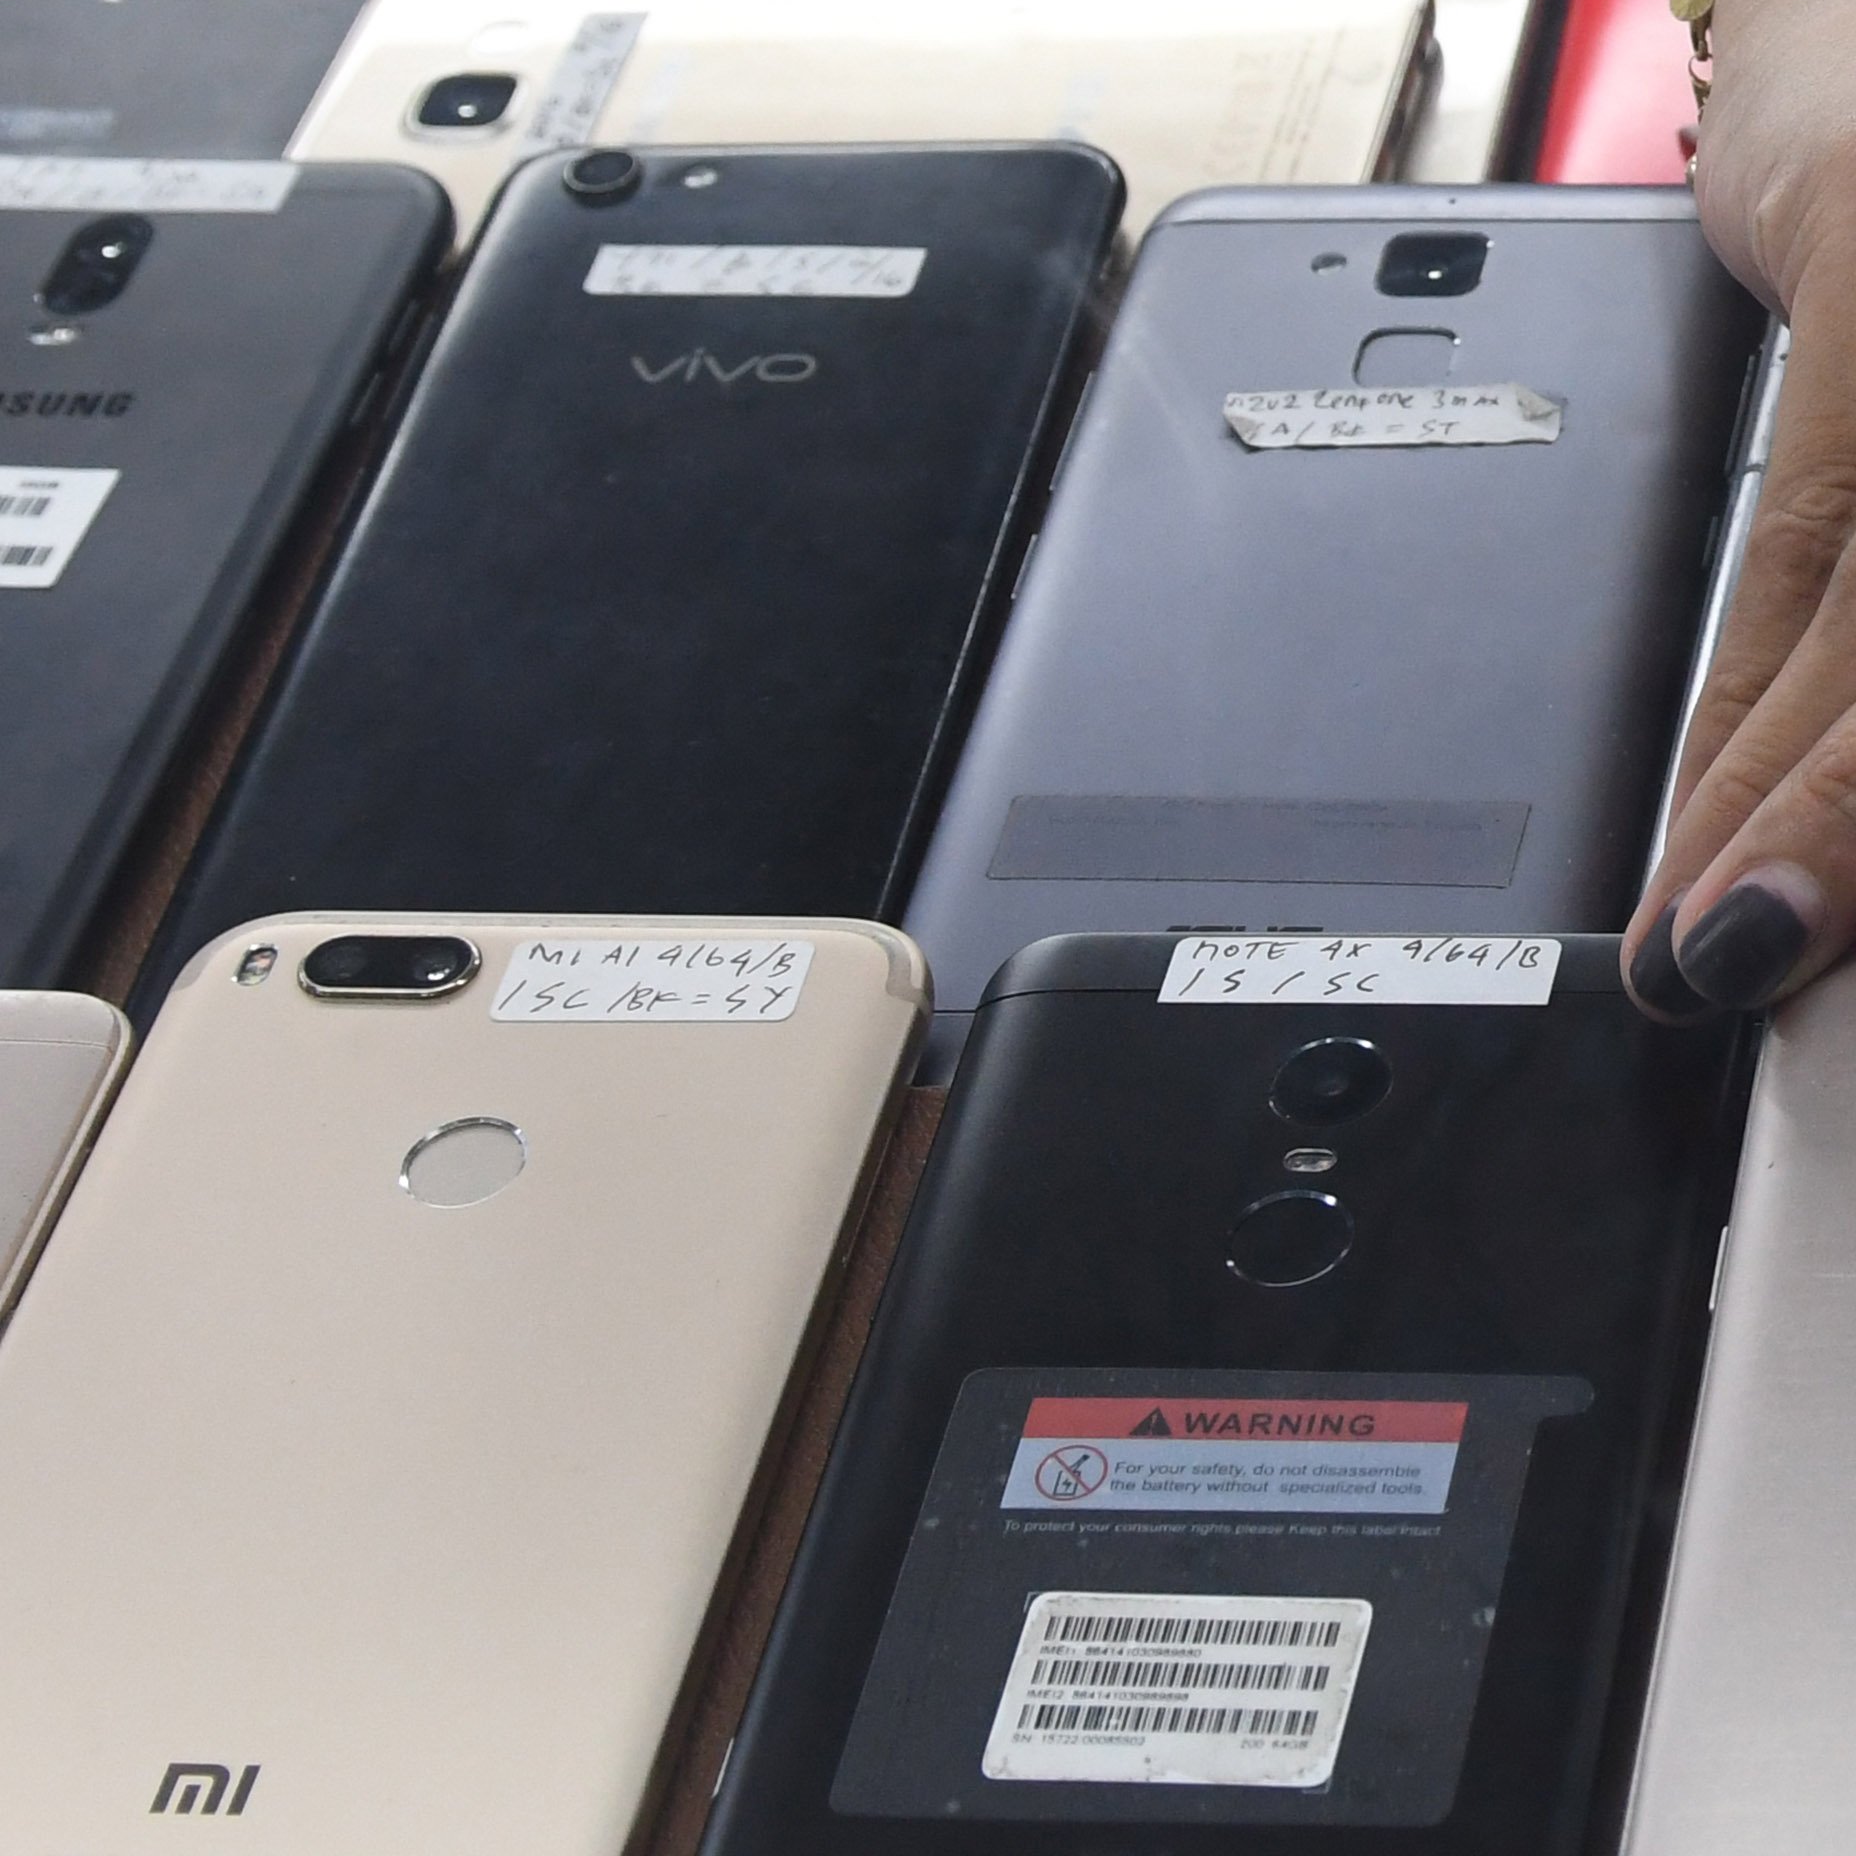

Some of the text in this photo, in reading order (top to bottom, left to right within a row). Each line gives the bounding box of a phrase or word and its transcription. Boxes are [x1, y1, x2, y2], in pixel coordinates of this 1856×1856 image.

[630, 346, 817, 383] vivo
[0, 392, 135, 416] SUNG
[1184, 1412, 1377, 1436] WARNING
[1114, 1461, 1421, 1479] For your safety, do not disassemble
[1110, 1479, 1136, 1492] the
[1142, 1480, 1201, 1495] battery
[1206, 1480, 1268, 1493] without
[1279, 1482, 1377, 1496] specialized
